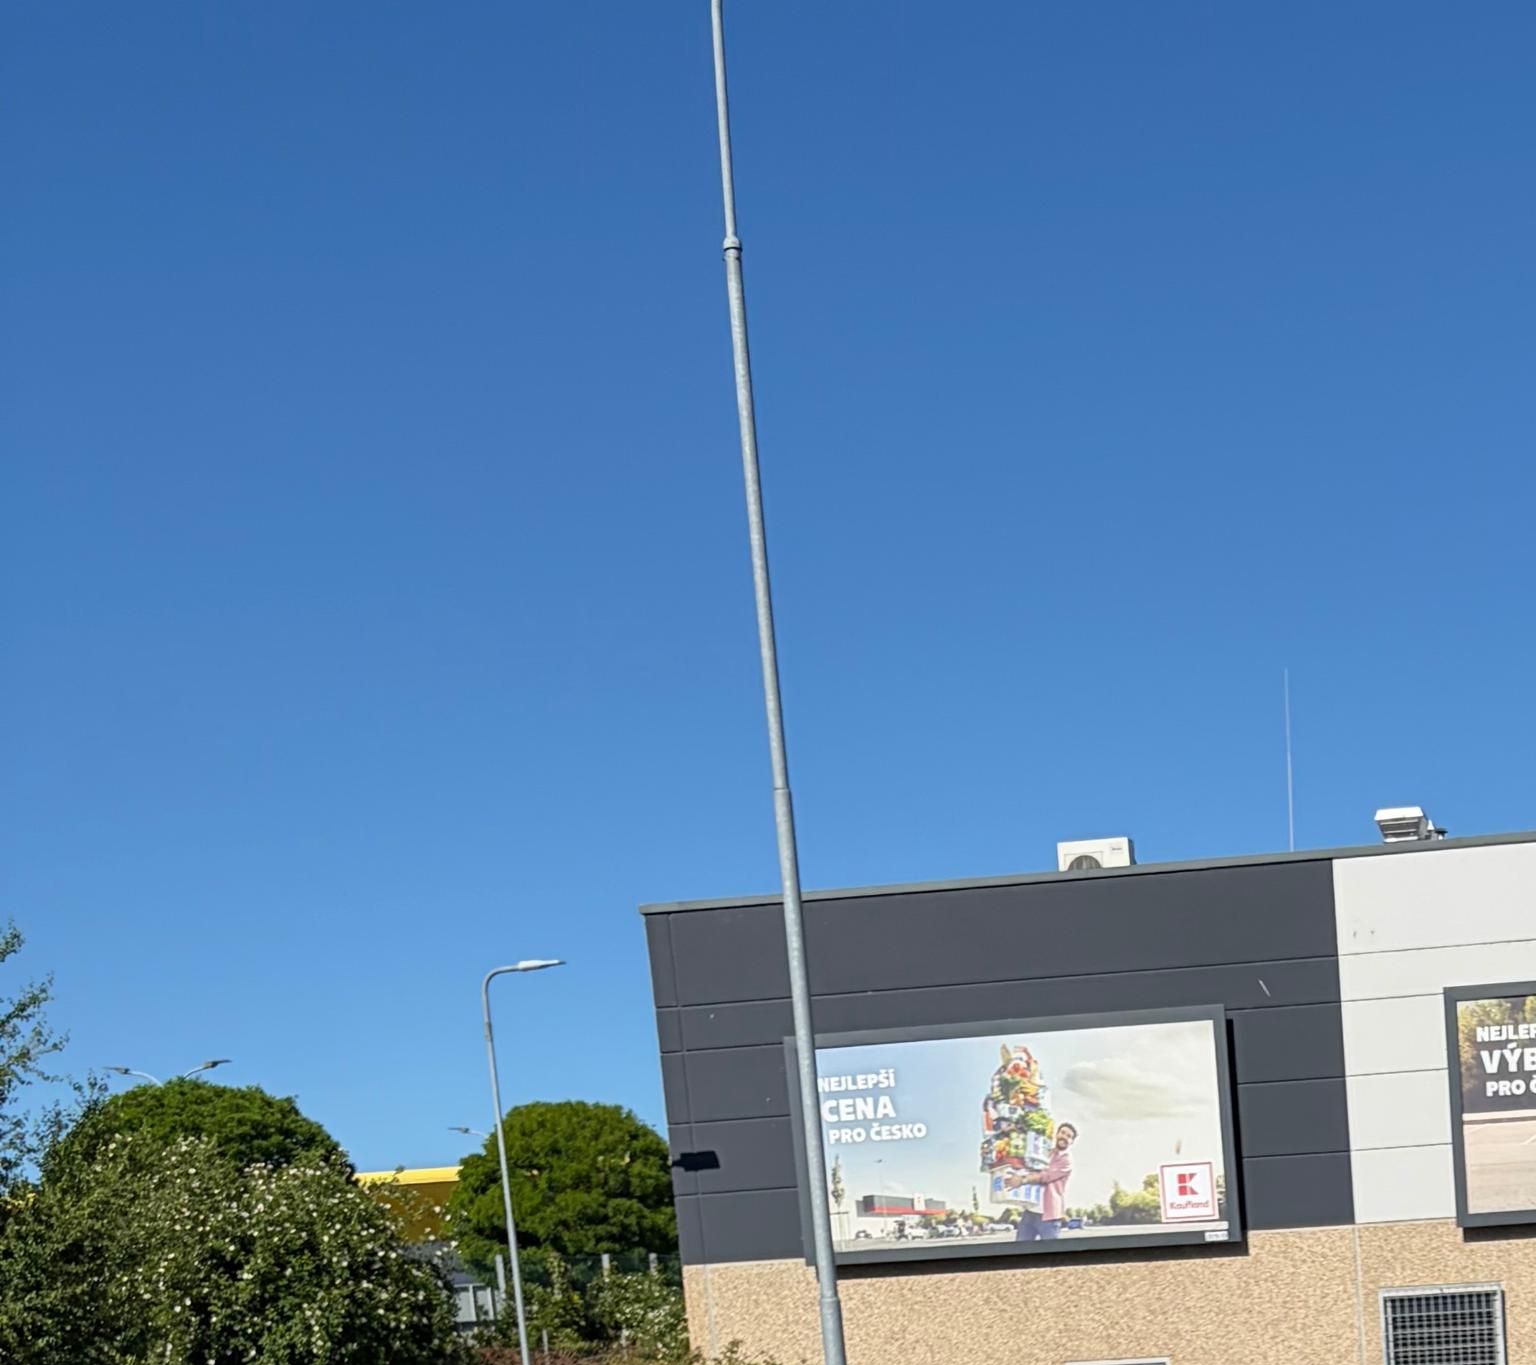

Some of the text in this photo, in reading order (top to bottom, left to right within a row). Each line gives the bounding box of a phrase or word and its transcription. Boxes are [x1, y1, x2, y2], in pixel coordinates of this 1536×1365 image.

[817, 1068, 896, 1093] NEJLEPŠÍ
[1485, 1079, 1527, 1098] PRO
[821, 1095, 897, 1123] CENA
[828, 1122, 928, 1145] PRO ČESKO
